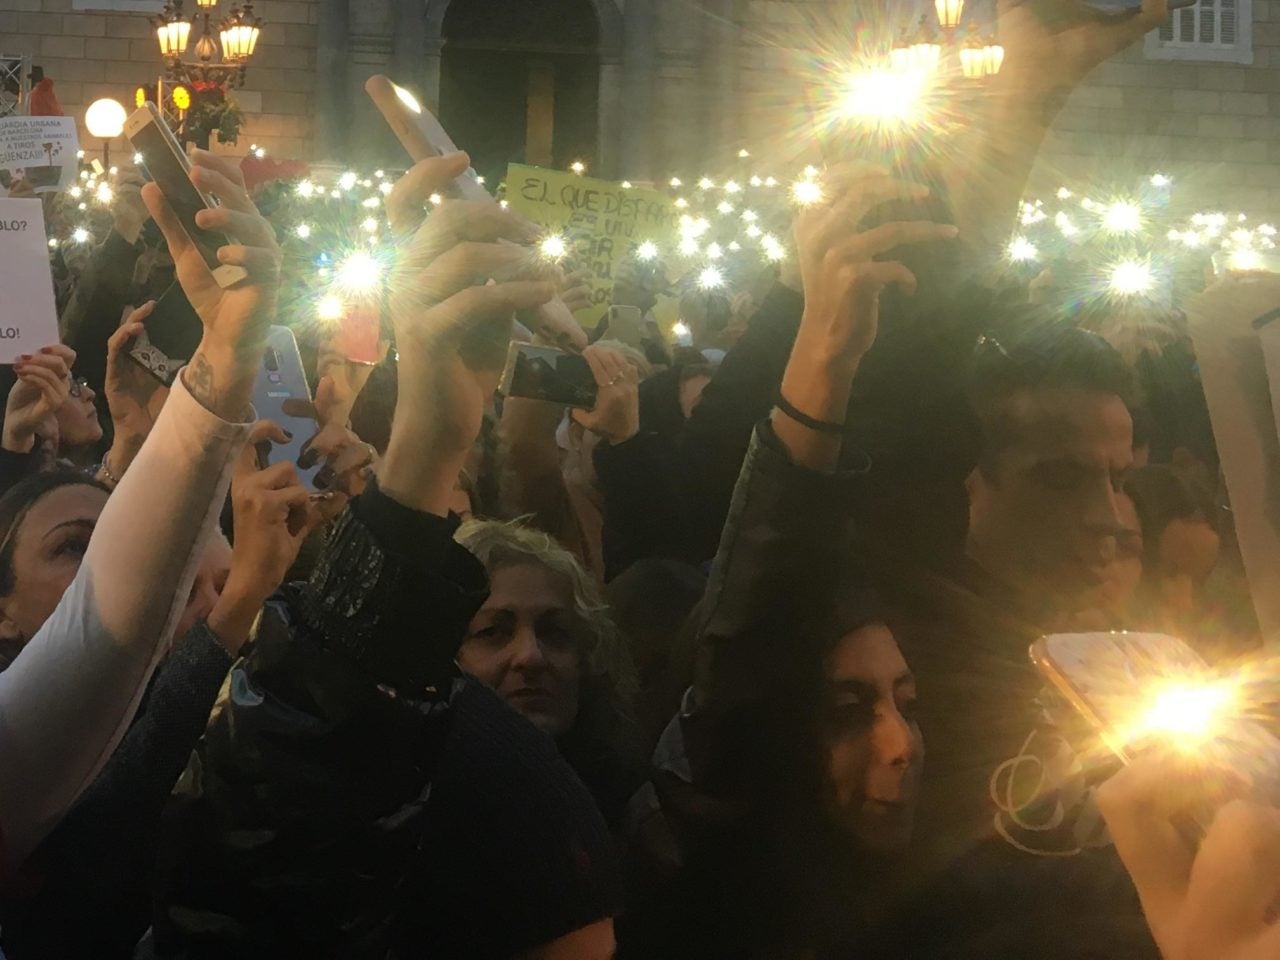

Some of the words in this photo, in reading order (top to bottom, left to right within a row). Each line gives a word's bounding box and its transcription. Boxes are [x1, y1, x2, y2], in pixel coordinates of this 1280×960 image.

[30, 119, 61, 127] URBANA
[13, 141, 36, 149] TIROS
[521, 178, 556, 205] EL
[561, 185, 598, 212] QUE
